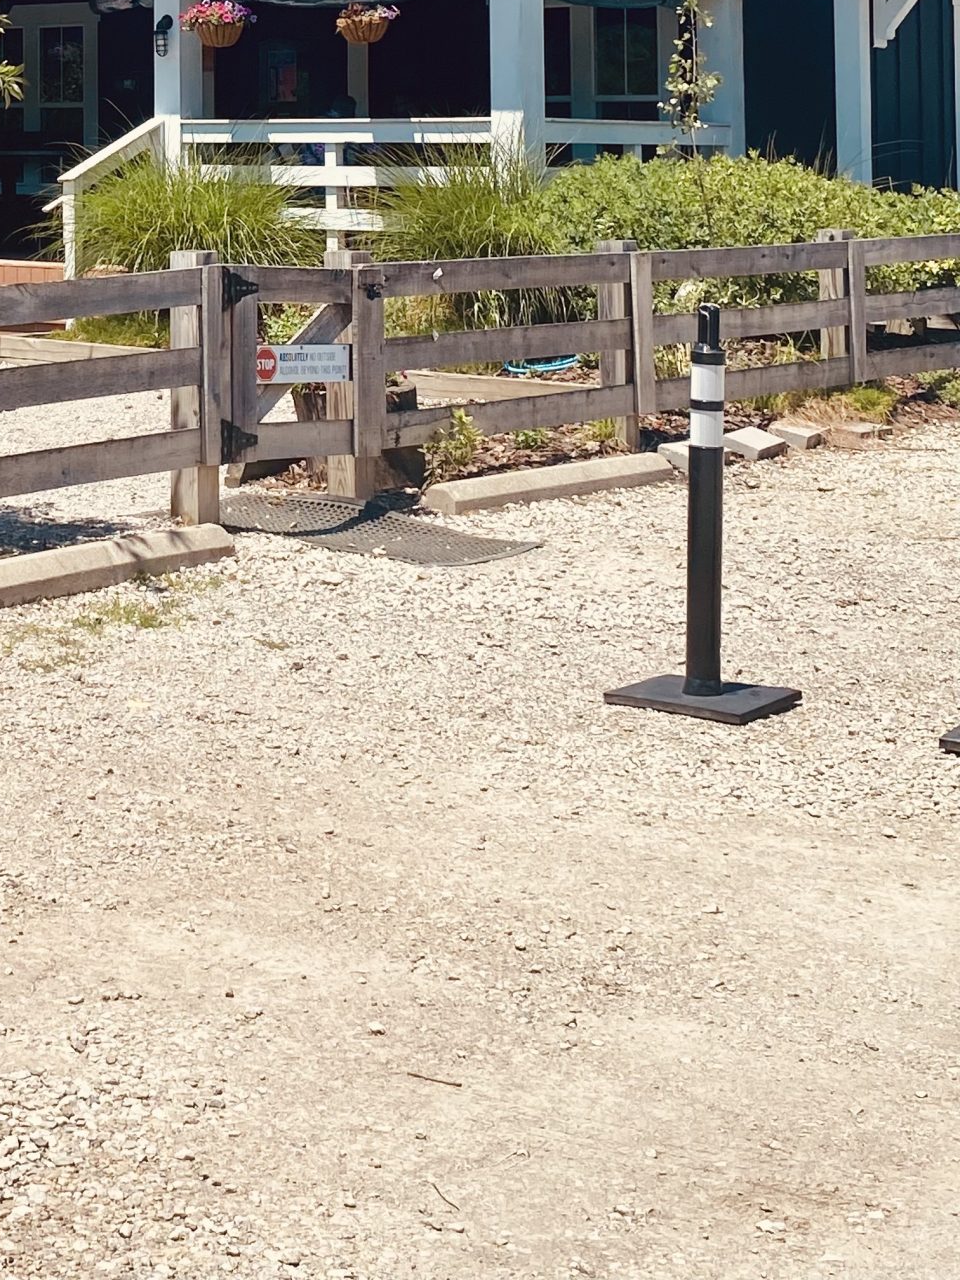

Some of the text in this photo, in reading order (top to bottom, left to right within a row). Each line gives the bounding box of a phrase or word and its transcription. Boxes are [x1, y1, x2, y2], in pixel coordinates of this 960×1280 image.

[279, 352, 336, 362] ABSOLUTELY NO OUTSIDE
[256, 358, 275, 370] STOP
